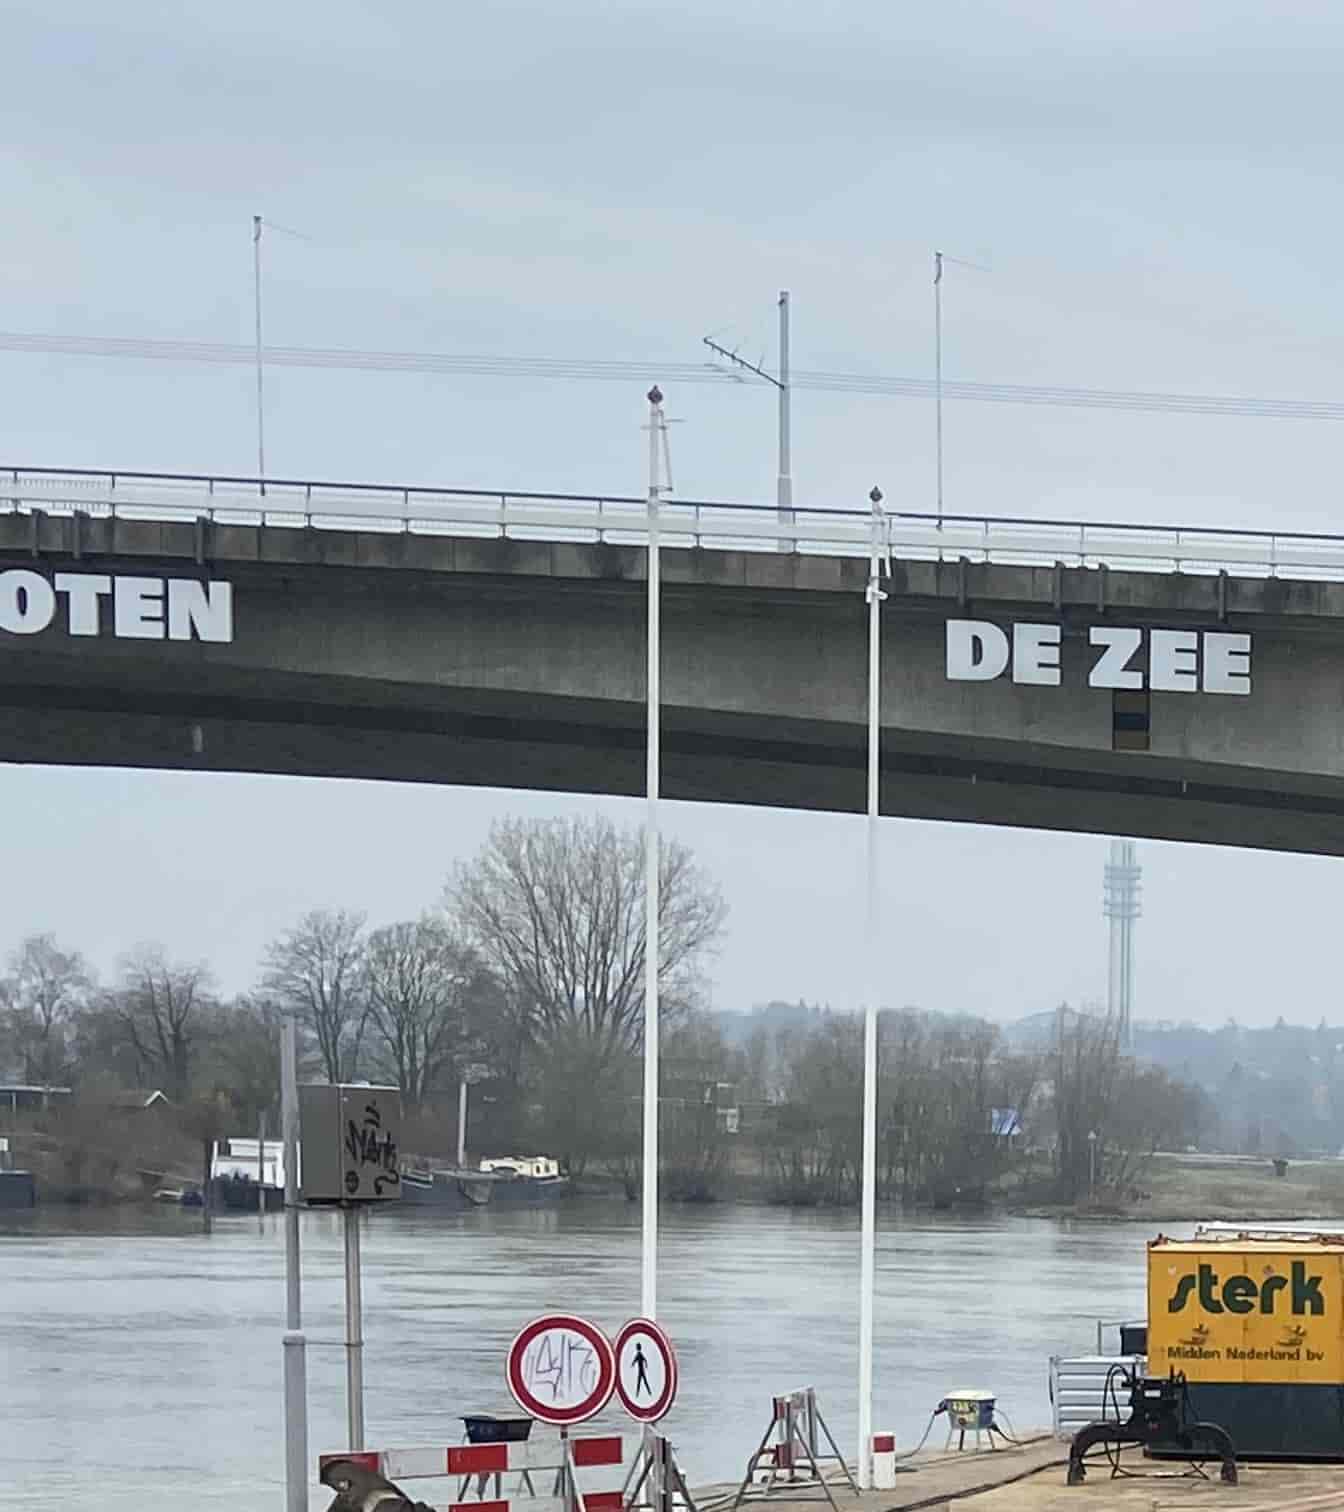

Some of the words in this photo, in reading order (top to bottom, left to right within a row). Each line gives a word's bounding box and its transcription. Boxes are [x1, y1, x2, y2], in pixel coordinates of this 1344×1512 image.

[0, 568, 232, 643] OTEN
[946, 619, 1062, 686] DE
[1088, 626, 1251, 695] ZEE
[1168, 1261, 1325, 1316] sterk
[1168, 1346, 1221, 1360] Midden
[1227, 1348, 1300, 1360] Nederland
[1307, 1348, 1325, 1361] bv
